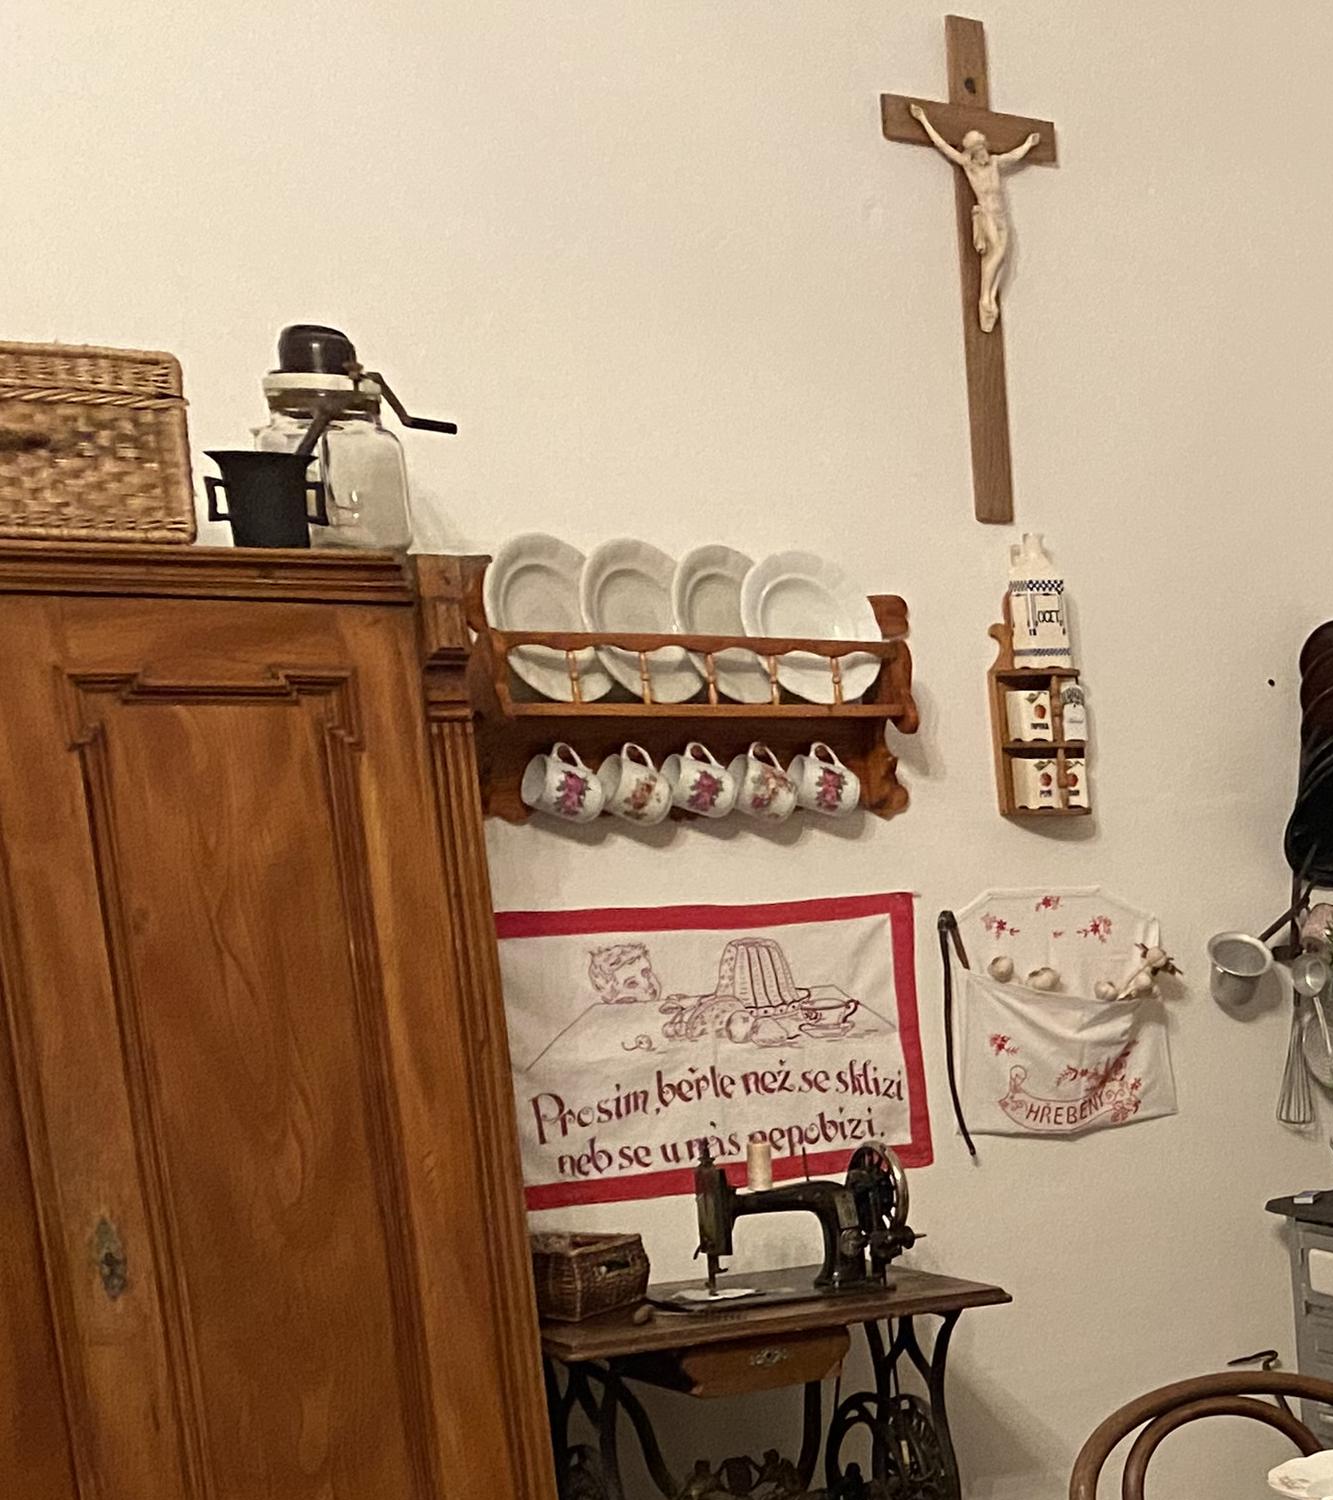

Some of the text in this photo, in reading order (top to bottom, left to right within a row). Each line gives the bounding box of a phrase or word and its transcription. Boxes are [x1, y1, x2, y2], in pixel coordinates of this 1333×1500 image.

[740, 1059, 794, 1096] než
[797, 1068, 831, 1094] se
[557, 1135, 613, 1177] neb
[618, 1145, 653, 1171] se
[660, 1141, 682, 1165] u
